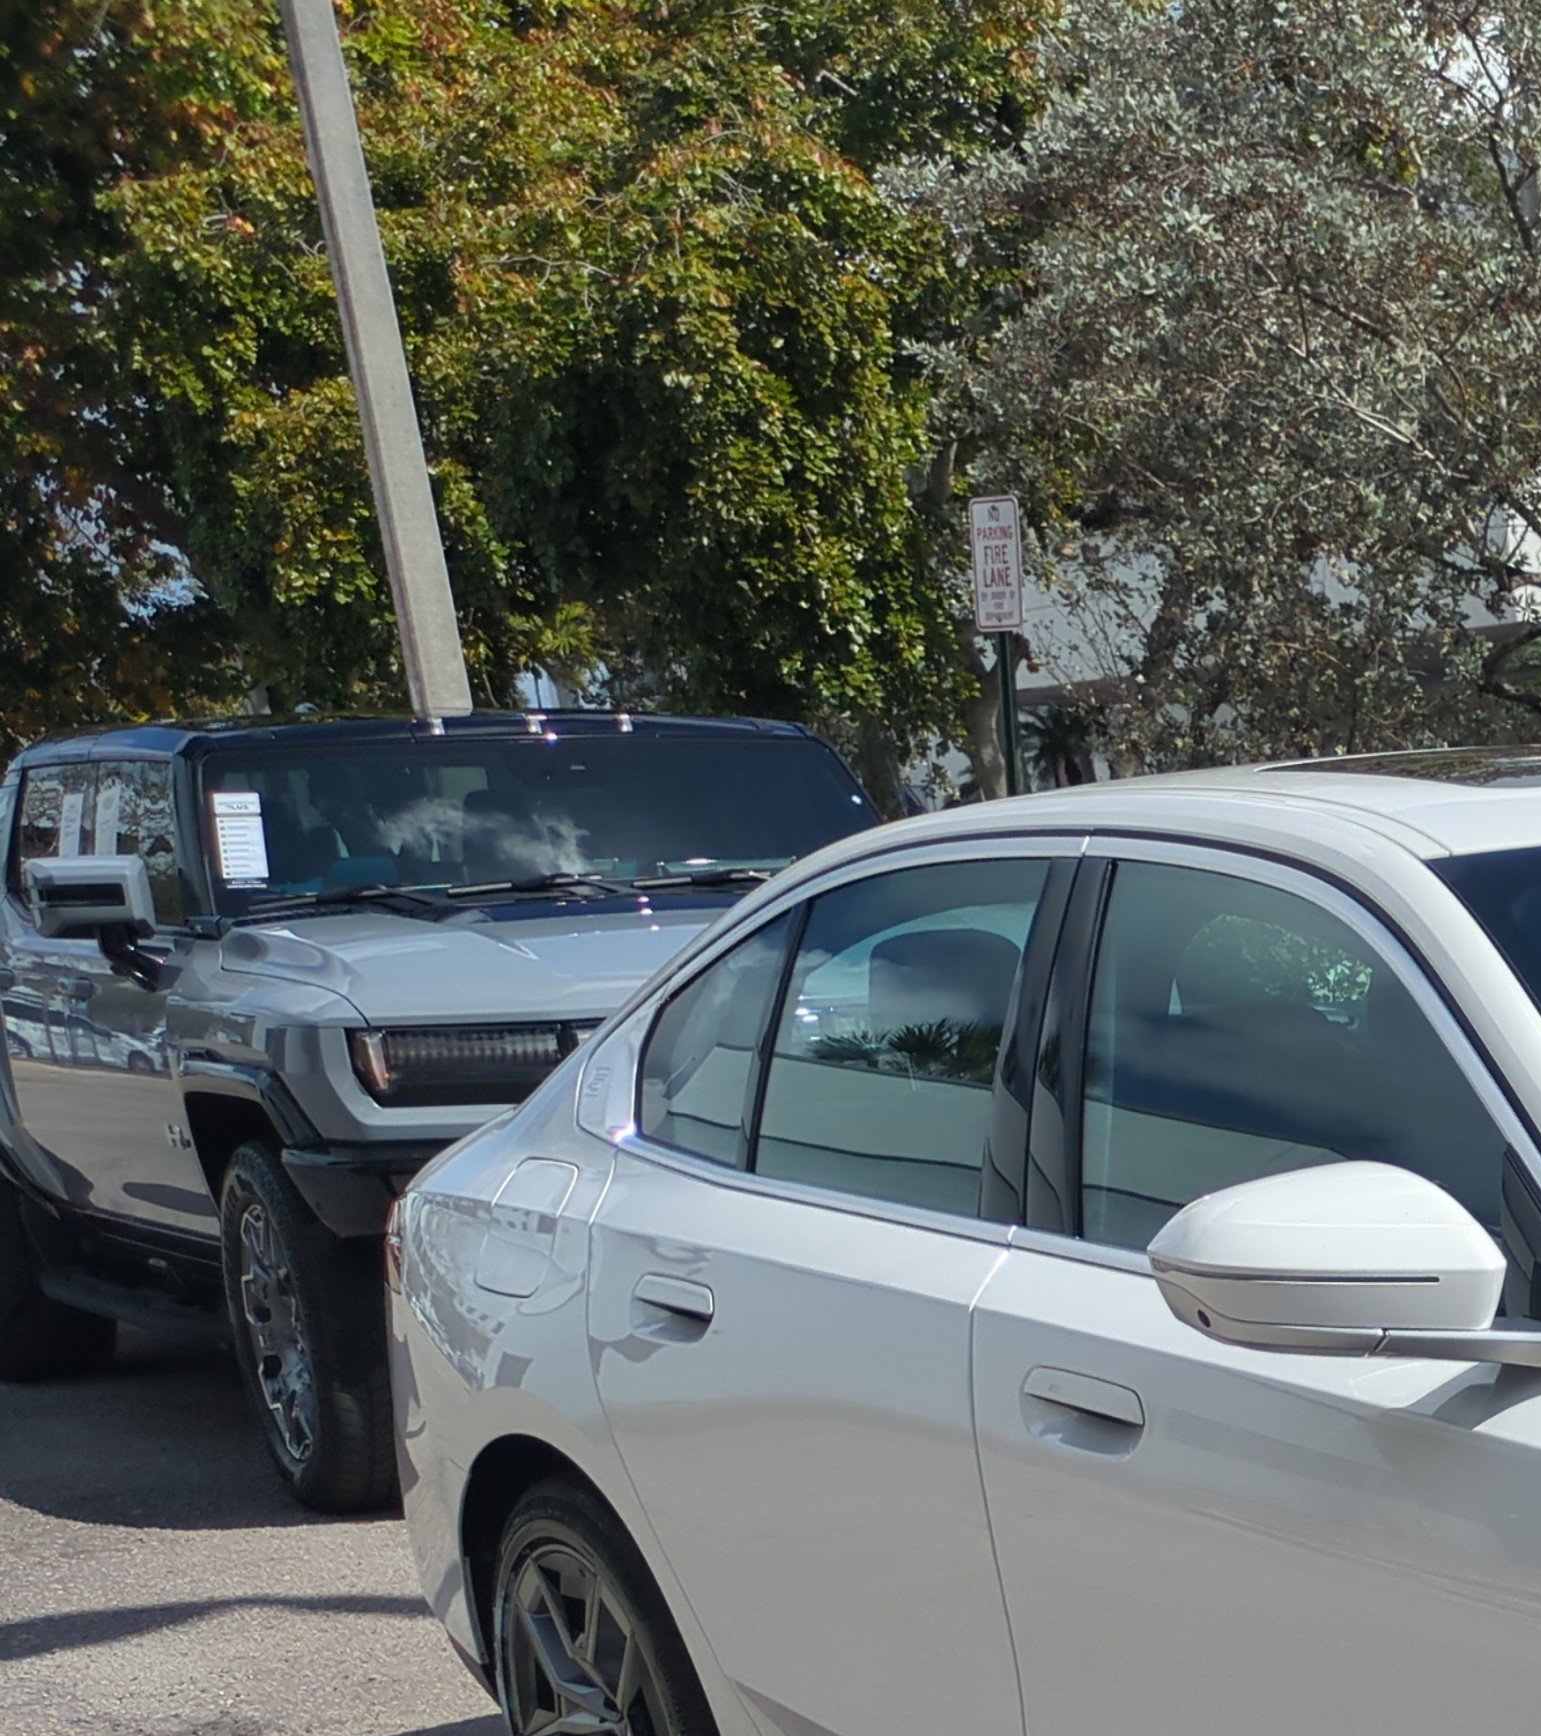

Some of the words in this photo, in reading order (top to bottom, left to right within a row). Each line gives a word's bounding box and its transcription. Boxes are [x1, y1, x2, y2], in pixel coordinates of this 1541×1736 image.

[987, 507, 1000, 522] NO
[977, 525, 1014, 541] PARKING
[984, 544, 1009, 565] FIRE
[984, 566, 1012, 588] LANE
